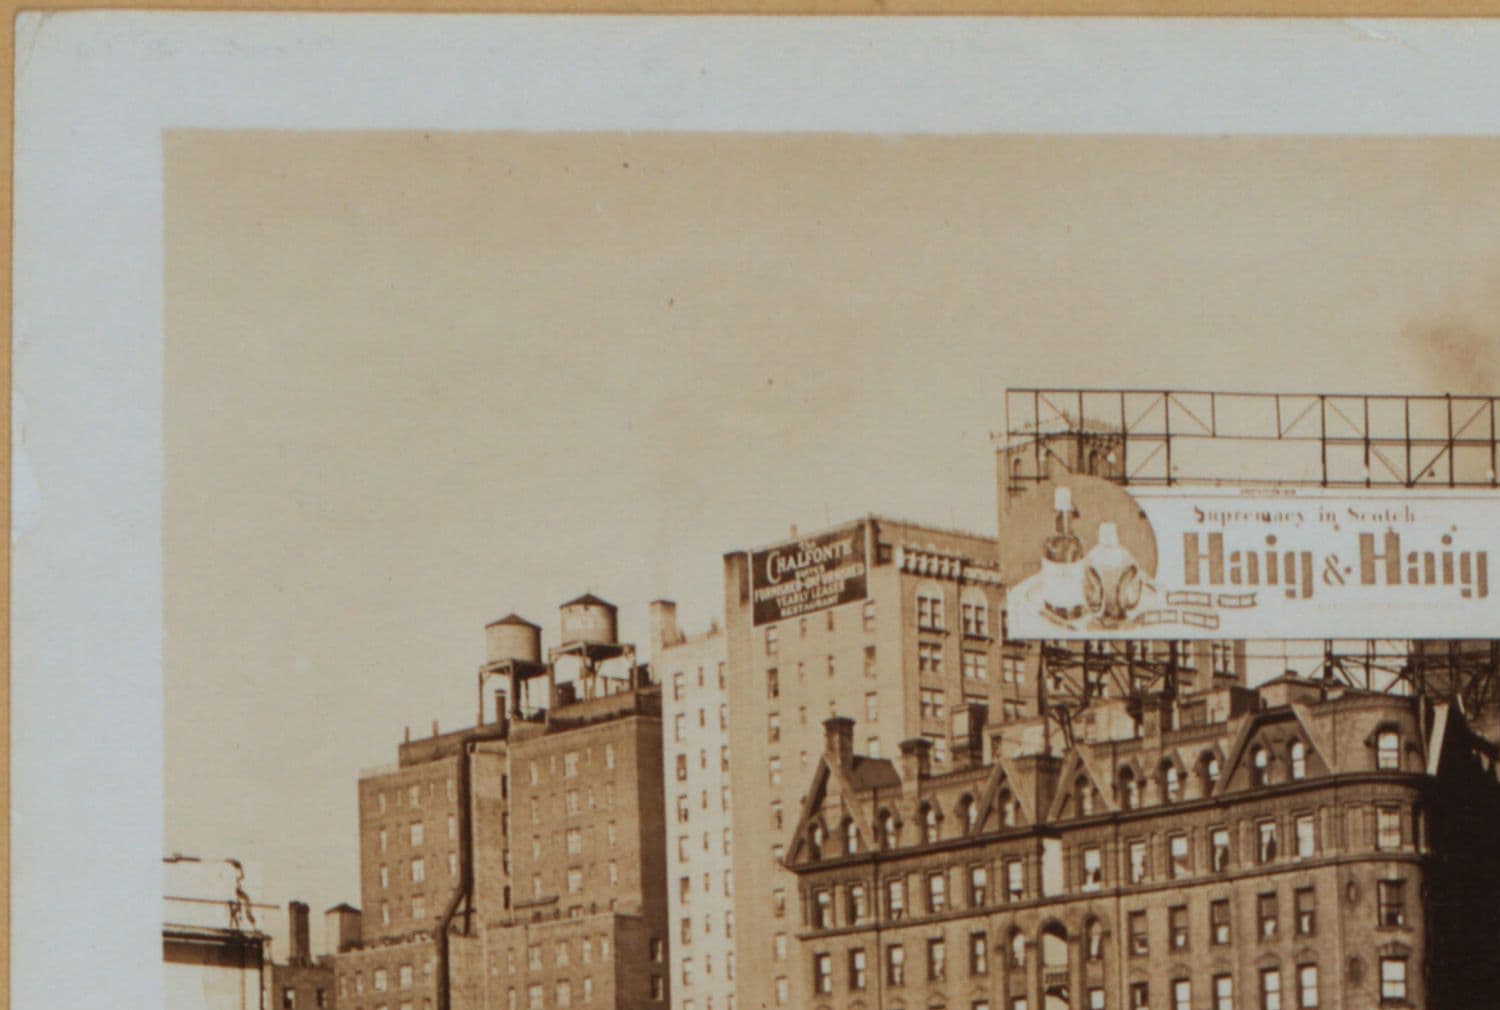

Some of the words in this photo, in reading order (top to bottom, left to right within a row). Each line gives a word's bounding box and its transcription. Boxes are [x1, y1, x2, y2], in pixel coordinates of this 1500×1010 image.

[1195, 504, 1305, 528] Supremacy
[1317, 505, 1337, 525] in
[1347, 504, 1417, 524] Scotch
[1183, 530, 1315, 599] Haig
[1322, 553, 1348, 586] &
[1358, 530, 1490, 599] Haig
